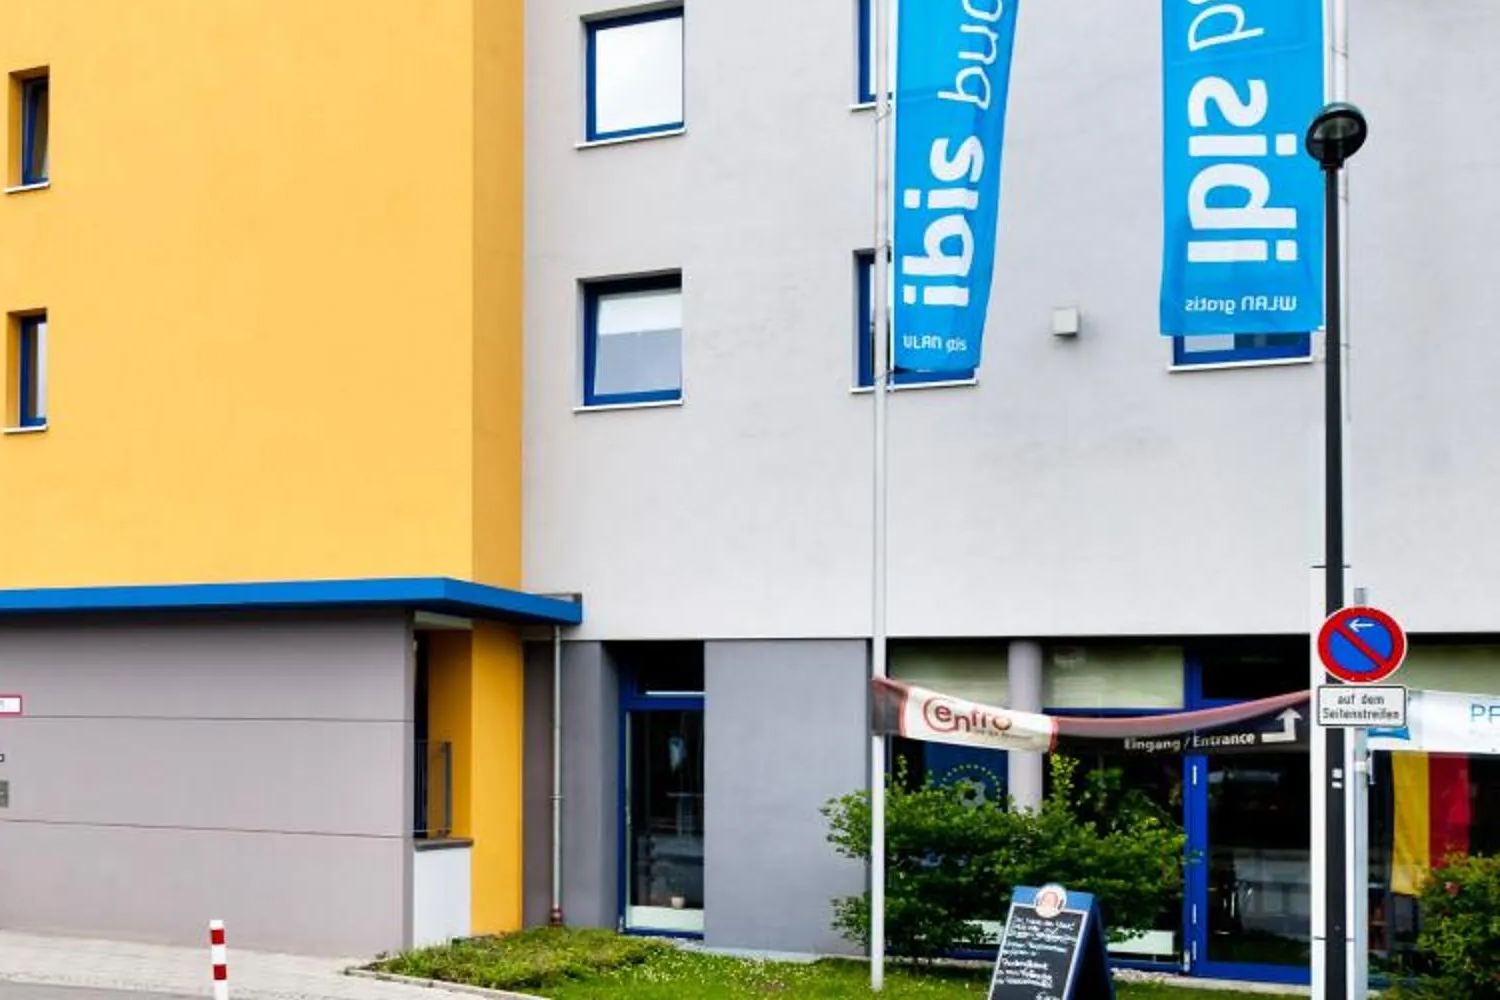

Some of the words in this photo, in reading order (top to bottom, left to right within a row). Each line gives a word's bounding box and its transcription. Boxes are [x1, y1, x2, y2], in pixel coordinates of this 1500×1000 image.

[901, 134, 985, 307] ibis
[1337, 693, 1356, 705] auf
[1361, 693, 1386, 705] dem
[1323, 707, 1400, 720] Seitenstreifen
[1124, 737, 1181, 753] Eingang
[1193, 732, 1256, 748] Entrance
